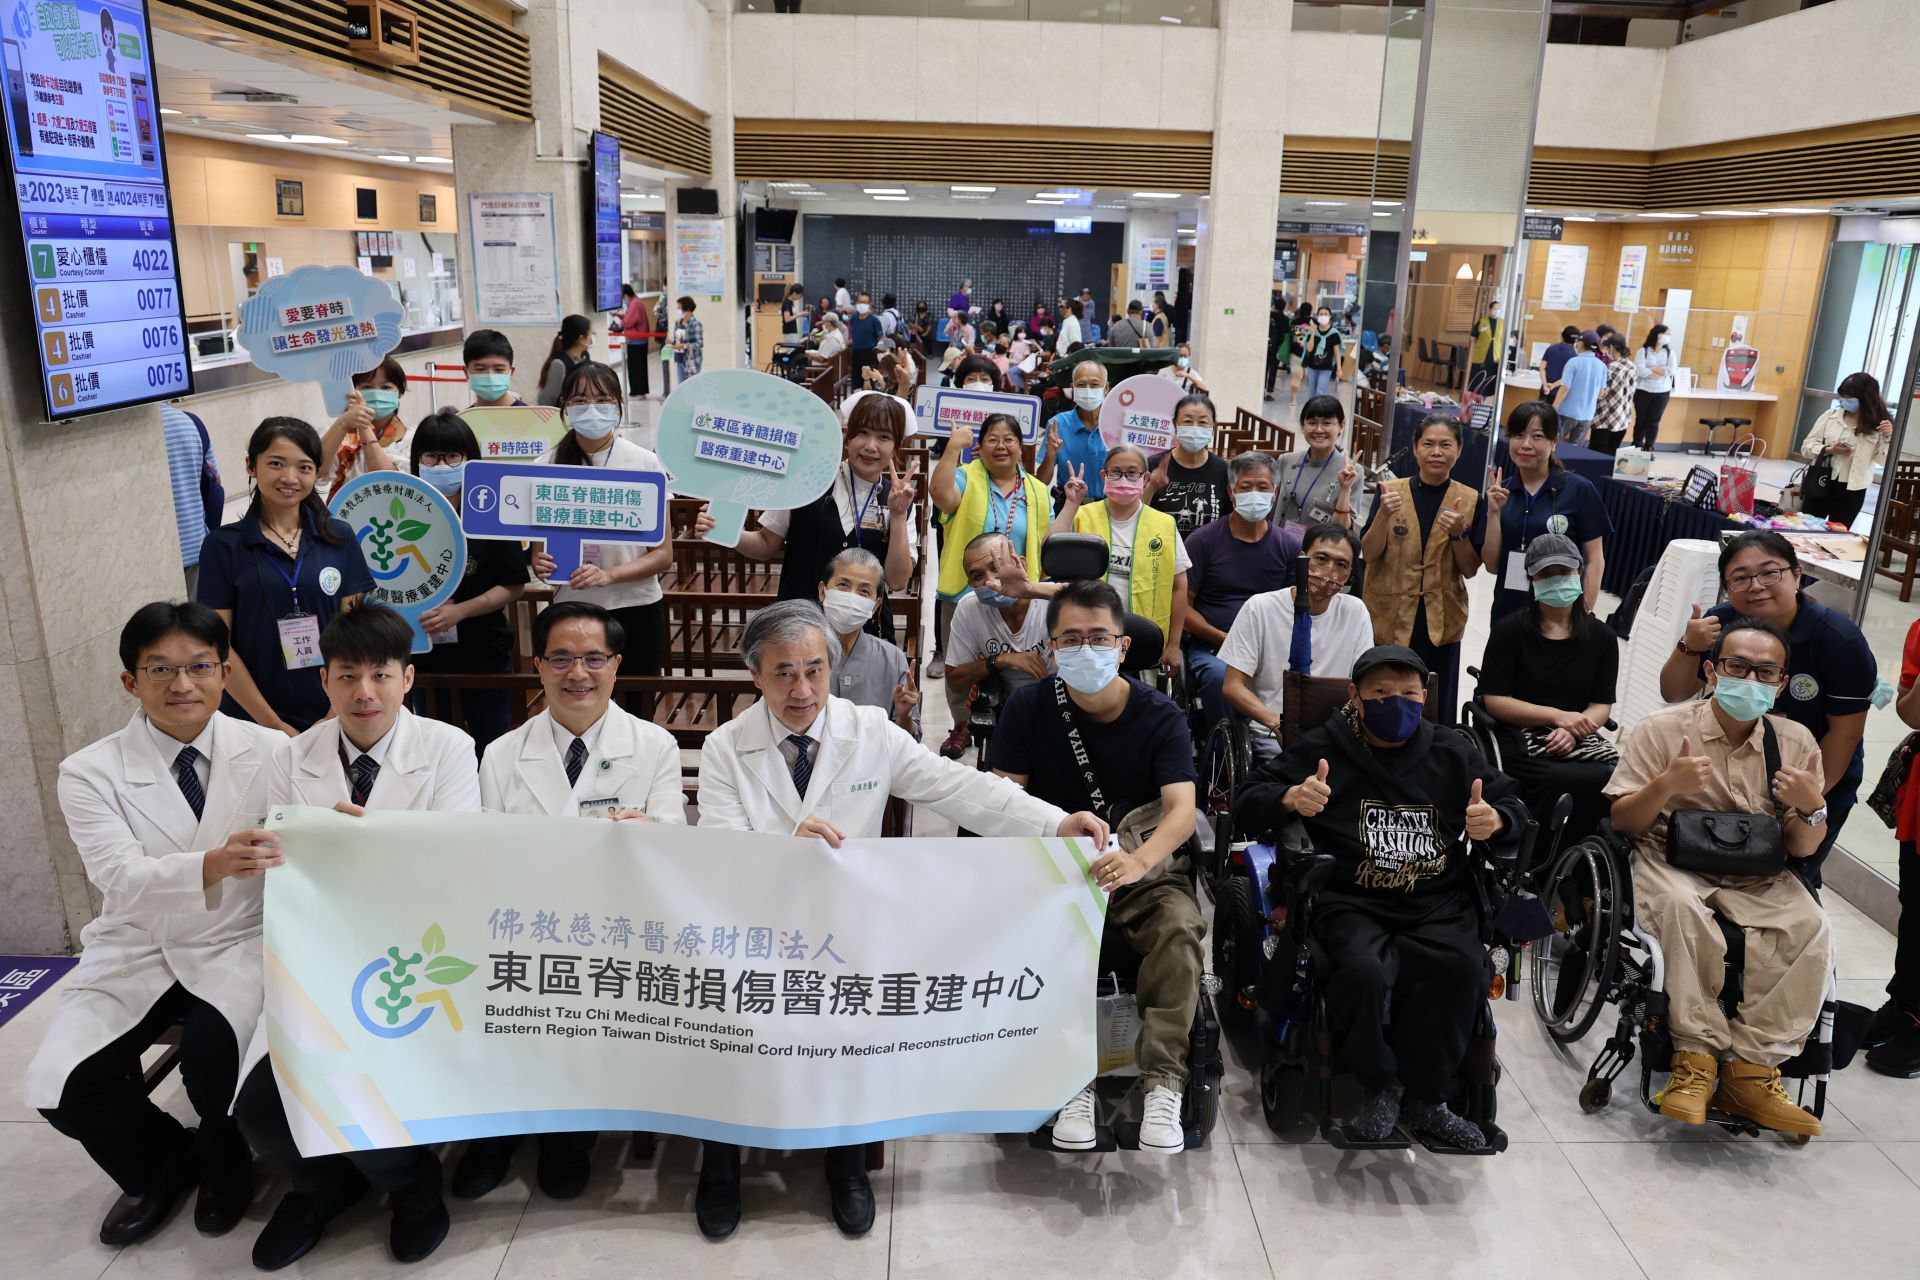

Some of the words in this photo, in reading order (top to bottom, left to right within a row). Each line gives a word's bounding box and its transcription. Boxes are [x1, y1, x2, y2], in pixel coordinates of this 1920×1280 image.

[29, 181, 64, 203] 2023
[81, 186, 88, 204] 7
[114, 191, 138, 206] 4024
[148, 194, 154, 207] 7
[38, 251, 47, 272] 7
[56, 247, 108, 267] 愛心櫃檯
[132, 249, 169, 271] 4022
[60, 269, 84, 277] Courtesy
[85, 268, 105, 276] Counter
[46, 296, 56, 316] 4
[62, 289, 89, 309] 批價
[137, 288, 172, 310] 0077
[285, 301, 345, 323] 愛要脊時
[66, 311, 86, 319] Cashier
[52, 338, 62, 358] 4
[69, 330, 95, 351] 批價
[142, 325, 178, 349] 0076
[271, 321, 376, 350] 讓生命發光發熱
[71, 352, 92, 361] Cashier
[58, 383, 68, 400] 6
[75, 372, 101, 393] 批價
[147, 362, 183, 387] 0075
[77, 393, 98, 402] Cashier
[712, 416, 799, 446] 東區脊髓損傷
[1129, 414, 1170, 430] 大愛有您
[488, 440, 543, 455] 脊時陪伴
[1128, 431, 1168, 447] 脊刻出發
[701, 440, 785, 470] 醫療重建中心
[535, 484, 642, 507] 東區脊髓損傷
[1166, 481, 1206, 493] F-16
[339, 483, 433, 519] 佛教慈濟醫療財團法人
[535, 506, 642, 528] 醫療重建中心
[369, 548, 453, 604] 傷醫療重建中心
[292, 635, 311, 645] 工作
[295, 646, 312, 656] 人員
[1068, 728, 1090, 766] HIYA
[1367, 831, 1437, 860] FASHION
[1375, 859, 1402, 872] vitality
[488, 908, 846, 964] 佛教慈濟醫療財團法人
[486, 950, 1045, 1017] 東區脊髓損傷醫療重建中心
[485, 1004, 551, 1018] Buddhist
[555, 1006, 582, 1020] Tzu
[585, 1008, 610, 1021] Chi
[614, 1010, 670, 1027] Medical
[674, 1016, 754, 1038] Foundation
[484, 1022, 541, 1034] Eastern
[546, 1024, 597, 1038] Region
[602, 1025, 651, 1041] Taiwan
[655, 1031, 706, 1048] District
[709, 1038, 754, 1054] Spinal
[757, 1044, 793, 1056] Cord
[797, 1045, 837, 1059] Injury
[841, 1043, 894, 1056] Medical
[898, 1032, 994, 1051] Reconstruction
[997, 1026, 1039, 1039] Center
